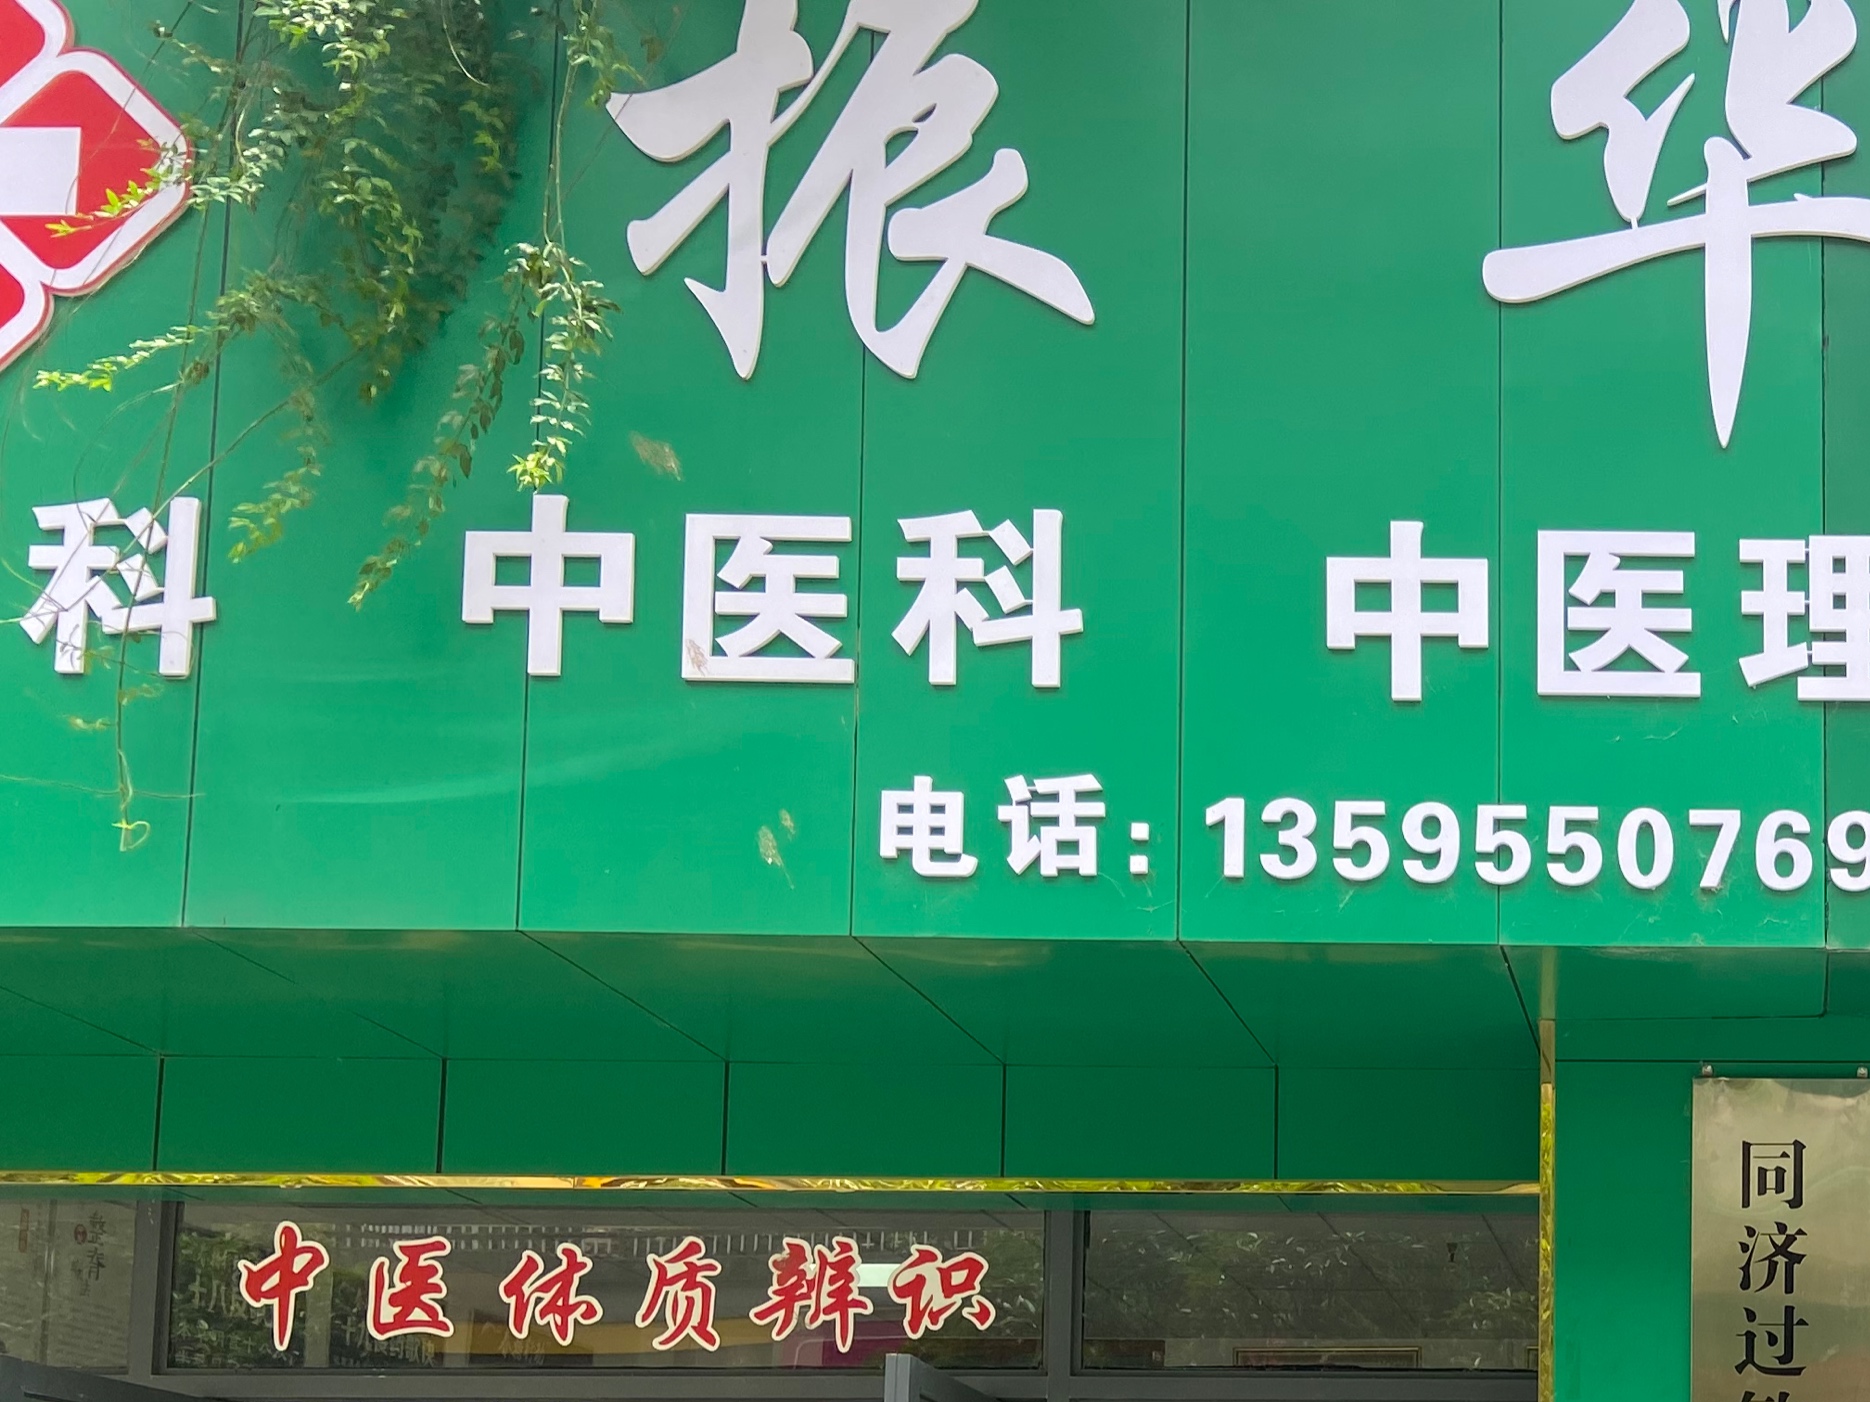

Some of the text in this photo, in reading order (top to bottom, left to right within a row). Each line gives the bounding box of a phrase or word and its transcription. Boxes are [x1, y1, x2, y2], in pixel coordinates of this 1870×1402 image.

[20, 497, 217, 677] 科
[462, 495, 1085, 688] 中医科
[238, 1221, 997, 1354] 中医体质辨识
